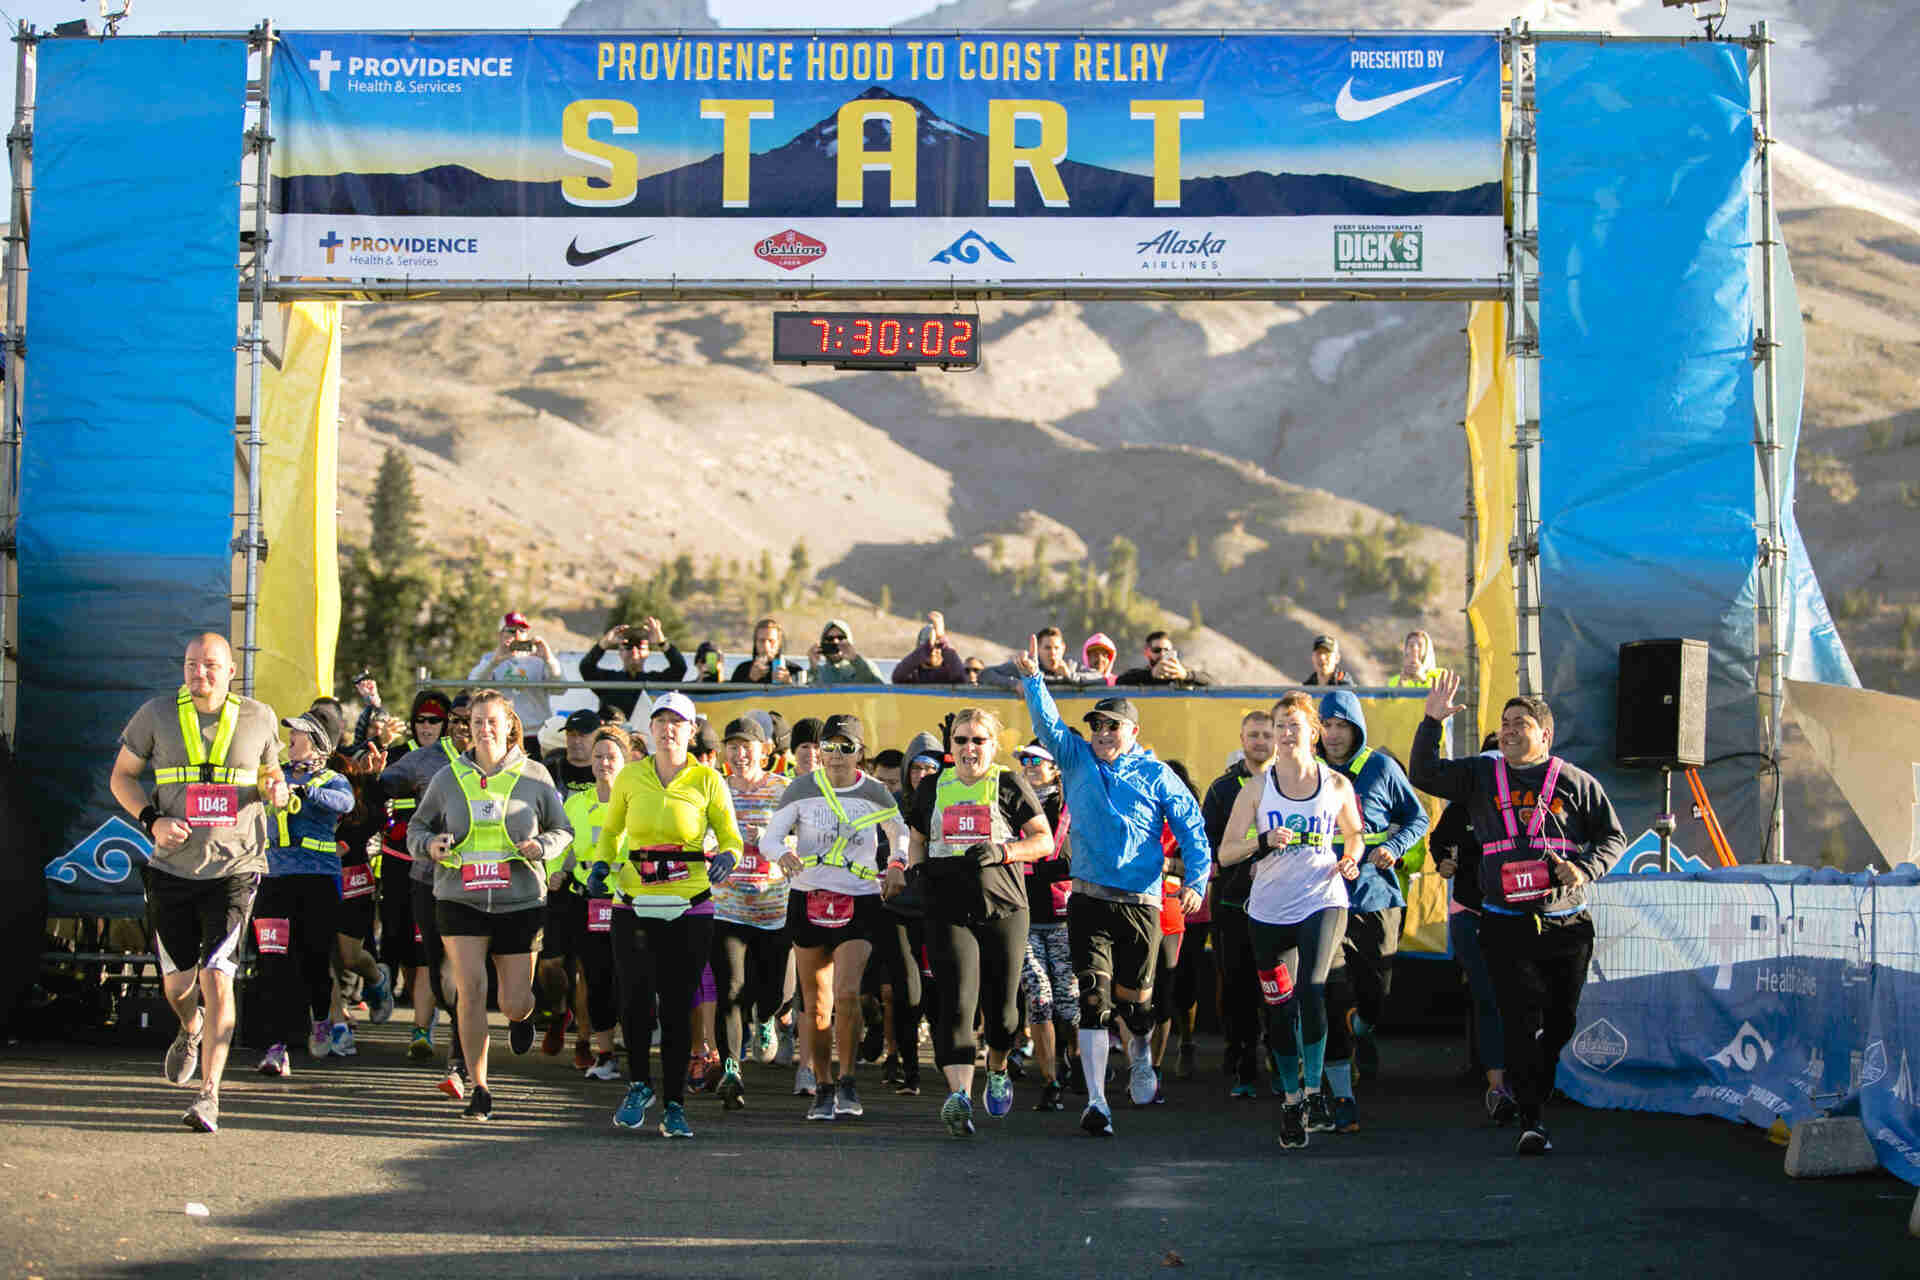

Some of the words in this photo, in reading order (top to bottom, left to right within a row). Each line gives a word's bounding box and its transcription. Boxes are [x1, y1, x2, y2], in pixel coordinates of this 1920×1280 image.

[348, 57, 512, 78] PROVIDENCE
[598, 42, 792, 81] PROVIDENCE
[806, 42, 894, 81] HOOD
[907, 42, 945, 81] TO
[959, 42, 1061, 81] COAST
[1074, 43, 1168, 82] RELAY
[1351, 50, 1424, 69] PRESENTED
[1427, 50, 1445, 68] BY
[348, 80, 393, 94] Health
[395, 80, 406, 94] &
[408, 80, 462, 94] Services
[561, 99, 1205, 208] START
[350, 237, 478, 254] PROVIDENCE
[758, 239, 823, 255] Session
[1137, 230, 1226, 256] Alaska
[1338, 232, 1419, 261] DICK'S
[350, 255, 384, 266] Health
[385, 255, 394, 266] &
[397, 255, 439, 267] Services
[1142, 261, 1218, 270] AIRLINES
[810, 318, 973, 357] 7:30:02
[198, 796, 229, 812] 1042
[958, 816, 975, 831] 50
[473, 863, 498, 876] 1172
[1516, 873, 1534, 888] 171
[826, 903, 835, 915] 4
[260, 928, 278, 941] 194
